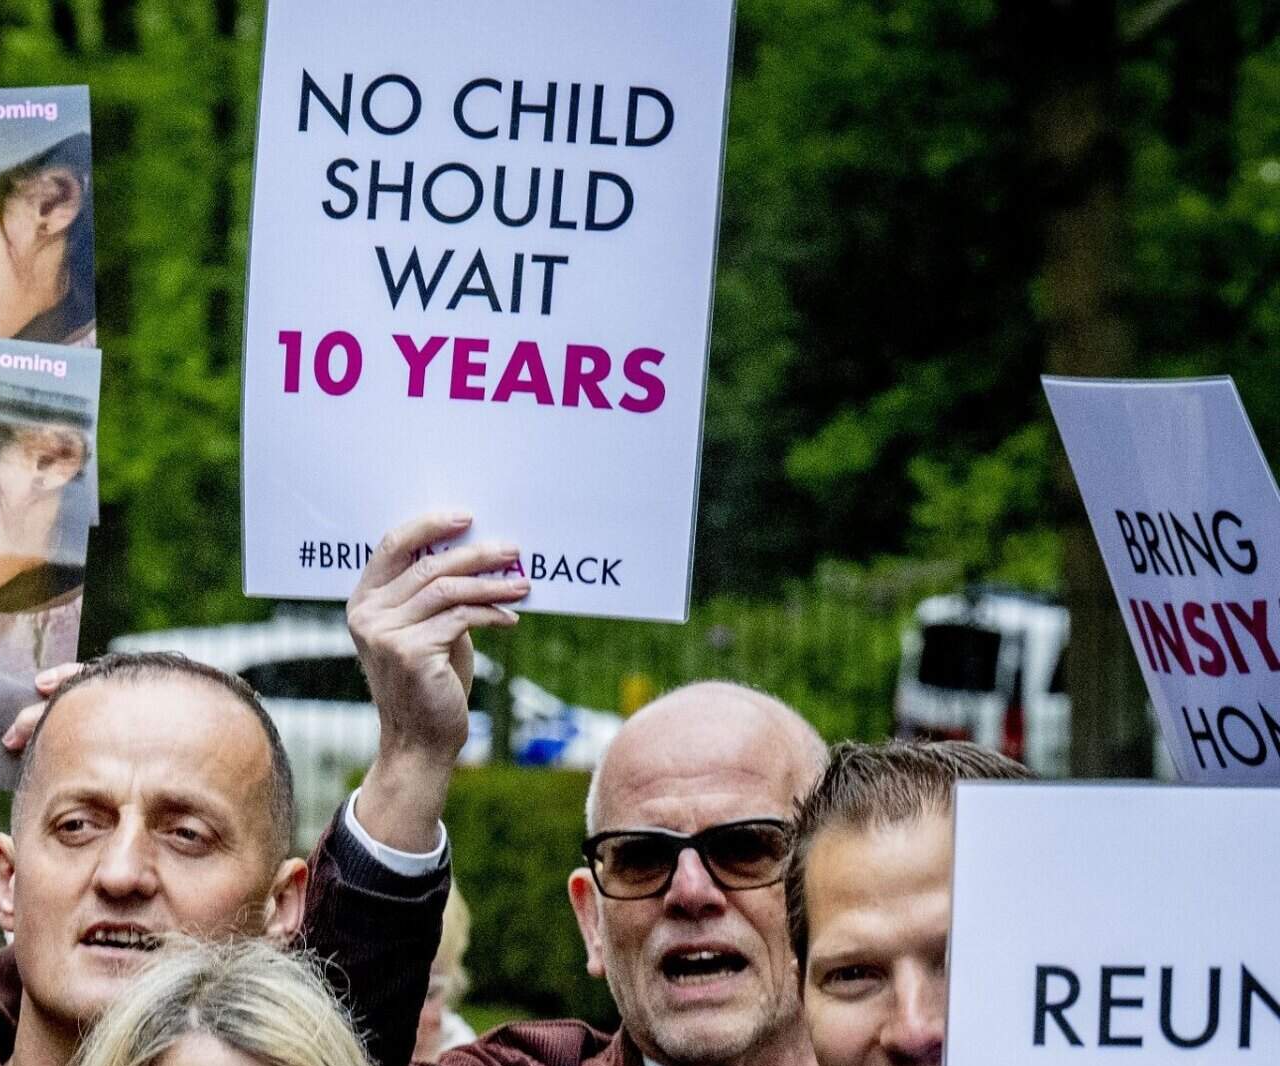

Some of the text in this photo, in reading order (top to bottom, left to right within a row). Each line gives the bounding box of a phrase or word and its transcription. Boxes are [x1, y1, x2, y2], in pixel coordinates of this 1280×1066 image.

[298, 68, 676, 148] NO CHILD
[321, 157, 636, 233] SHOULD
[374, 245, 570, 317] WAIT
[278, 330, 667, 415] 10 YEARS
[1114, 509, 1259, 578] BRING
[1128, 598, 1280, 678] INSIY
